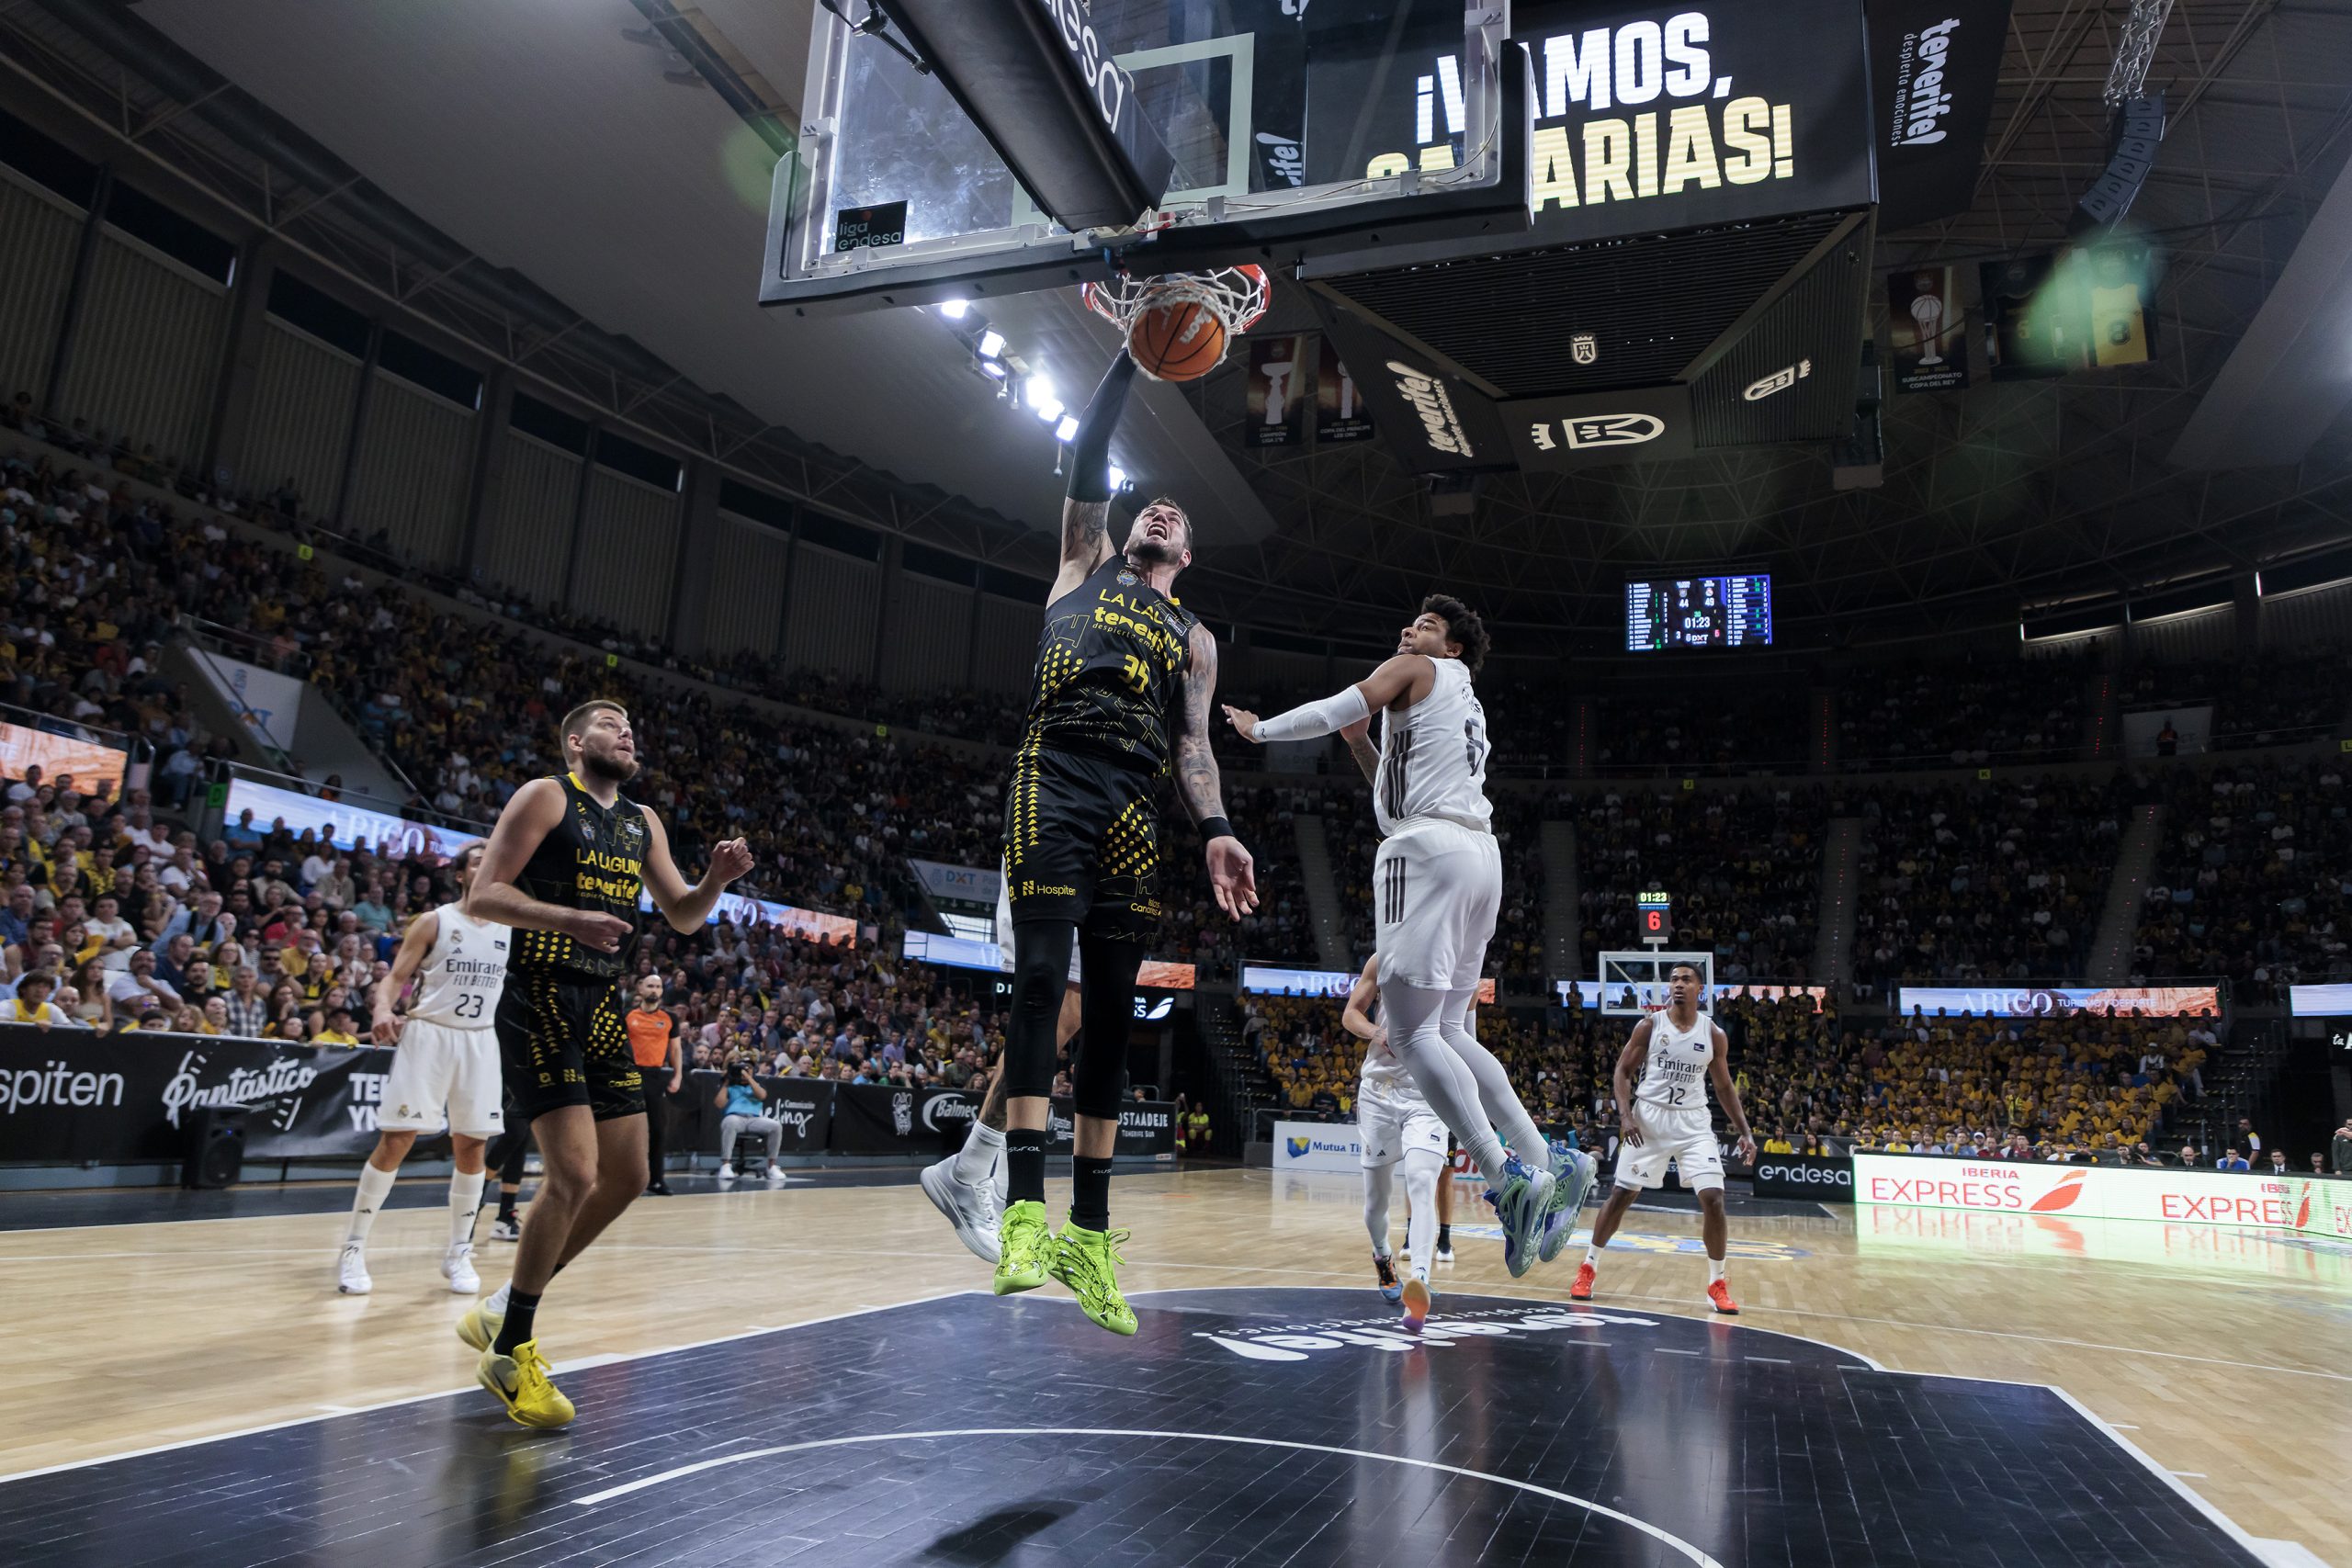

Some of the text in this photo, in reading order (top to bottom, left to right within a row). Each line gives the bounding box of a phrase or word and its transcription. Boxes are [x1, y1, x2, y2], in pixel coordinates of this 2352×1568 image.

[1898, 33, 1918, 85] despierta
[1899, 17, 1961, 145] tenerife!
[1366, 96, 1793, 213] ARIAS!
[839, 222, 868, 237] liga
[838, 231, 902, 251] endesa
[1902, 372, 1962, 383] SUBCAMPEONATO
[1099, 588, 1125, 607] LA
[1684, 616, 1711, 628] 01:23
[1120, 653, 1150, 695] 35
[576, 847, 597, 866] LA
[946, 870, 977, 885] DXT
[1640, 892, 1667, 902] 01:23
[1648, 911, 1661, 931] 6
[446, 958, 505, 977] Emirates
[453, 975, 469, 986] FLY
[454, 993, 484, 1019] 23
[1959, 992, 2052, 1014] ARICO
[2057, 998, 2101, 1008] TURISMO
[2112, 998, 2156, 1009] DEPORTE
[1657, 1056, 1703, 1074] Emirates
[1662, 1069, 1675, 1080] FLY
[1668, 1086, 1686, 1106] 12
[935, 1100, 979, 1127] Balmes
[1313, 1141, 1346, 1152] Mutua
[1758, 1163, 1851, 1187] endesa
[1962, 1168, 2019, 1179] IBERIA
[1871, 1178, 2022, 1209] EXPRESS
